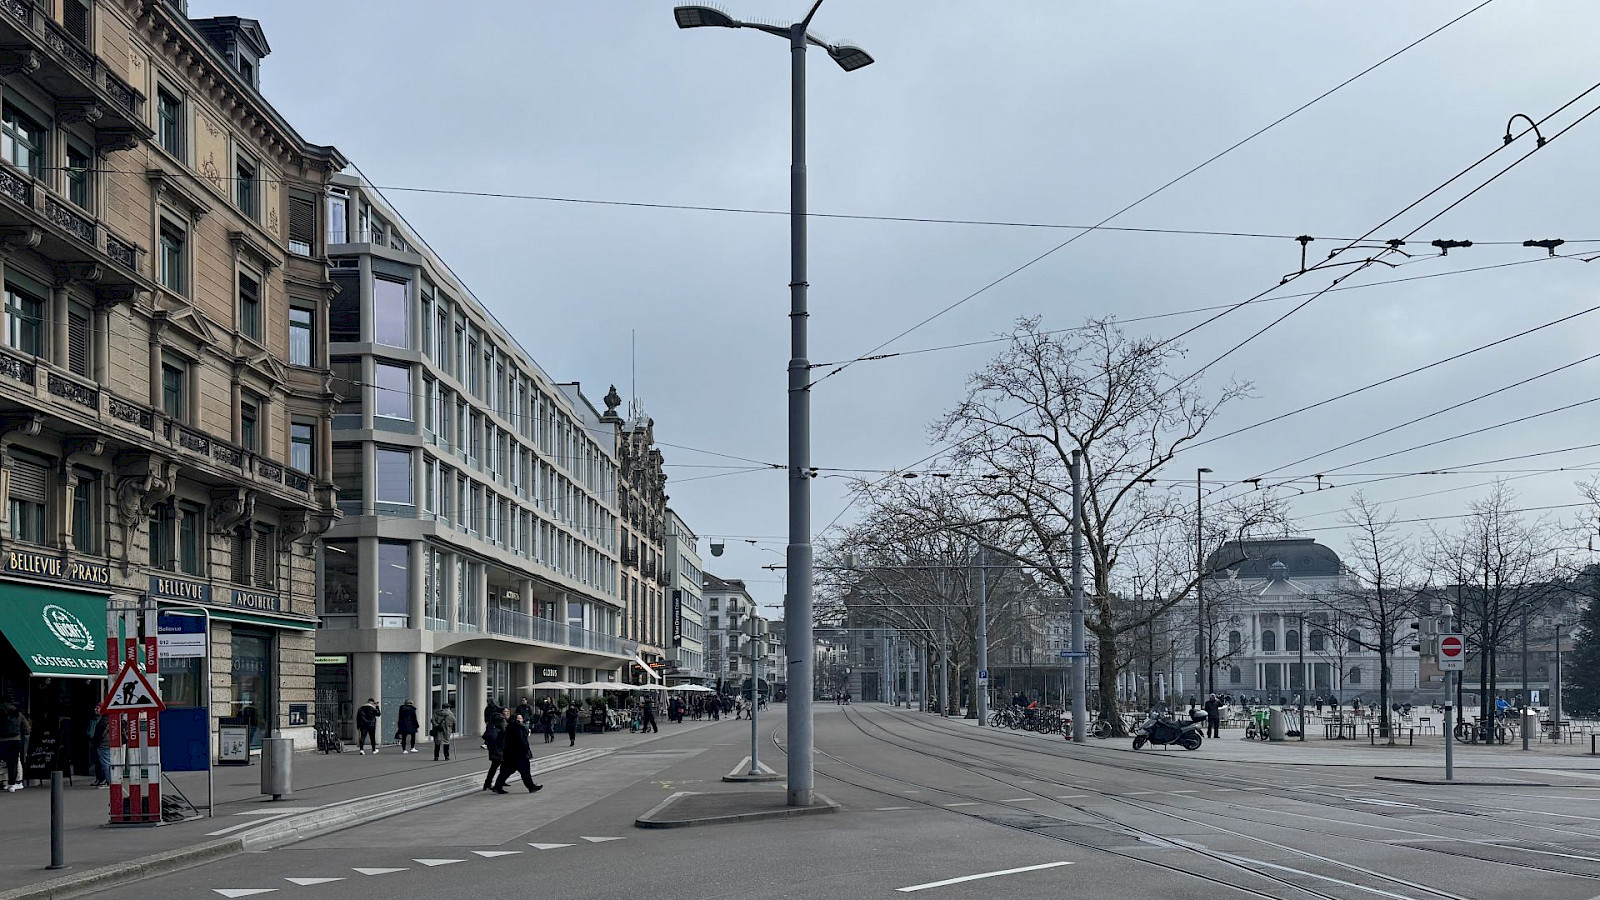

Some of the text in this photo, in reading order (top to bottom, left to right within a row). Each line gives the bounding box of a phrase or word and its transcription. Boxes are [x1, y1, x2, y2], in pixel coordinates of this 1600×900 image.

[10, 552, 109, 584] BELLEVUE PRAXIS
[159, 579, 275, 610] BELLEVUE APOTHEKE
[32, 654, 79, 667] RÖSTEREI
[79, 659, 88, 668] &
[543, 668, 558, 677] GLOBUS
